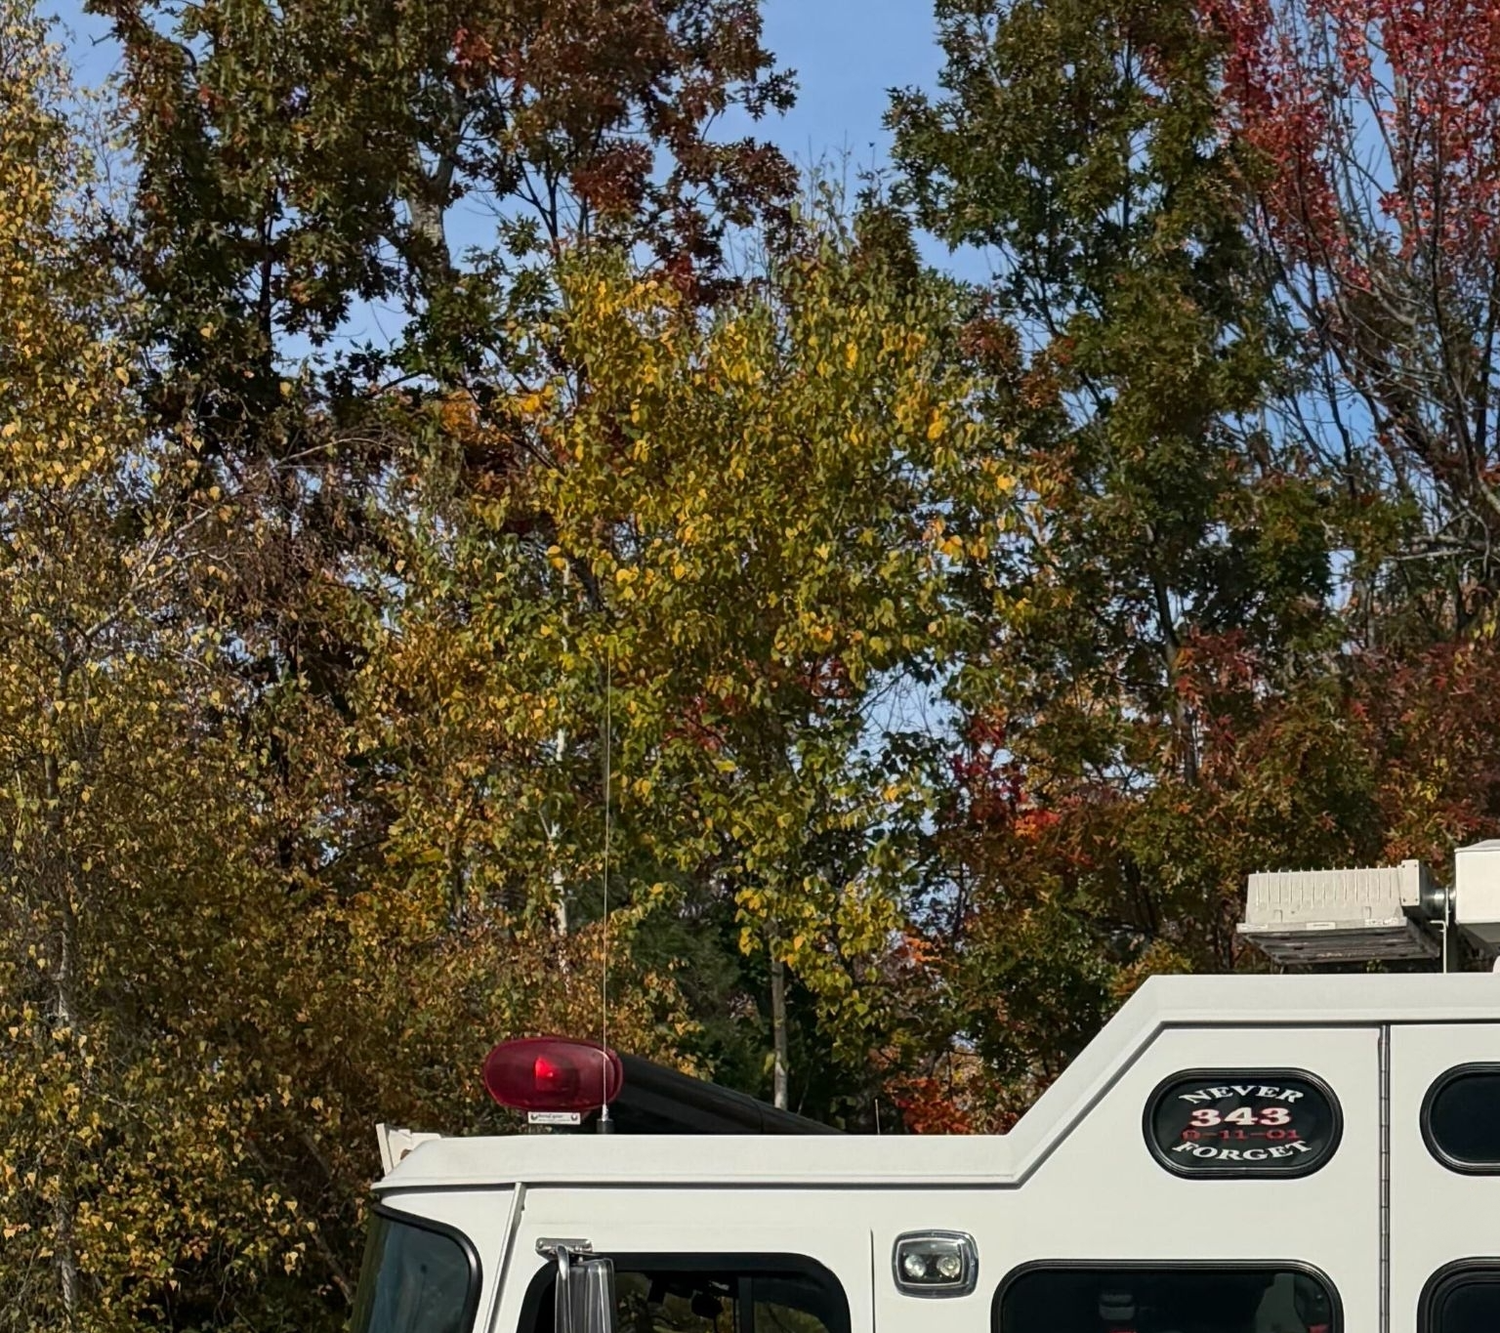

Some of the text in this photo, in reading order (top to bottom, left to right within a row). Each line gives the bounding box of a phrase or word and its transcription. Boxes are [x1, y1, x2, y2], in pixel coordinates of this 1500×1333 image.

[1178, 1085, 1304, 1104] NEVER
[1190, 1107, 1291, 1127] 343
[1172, 1140, 1312, 1161] FORGET
